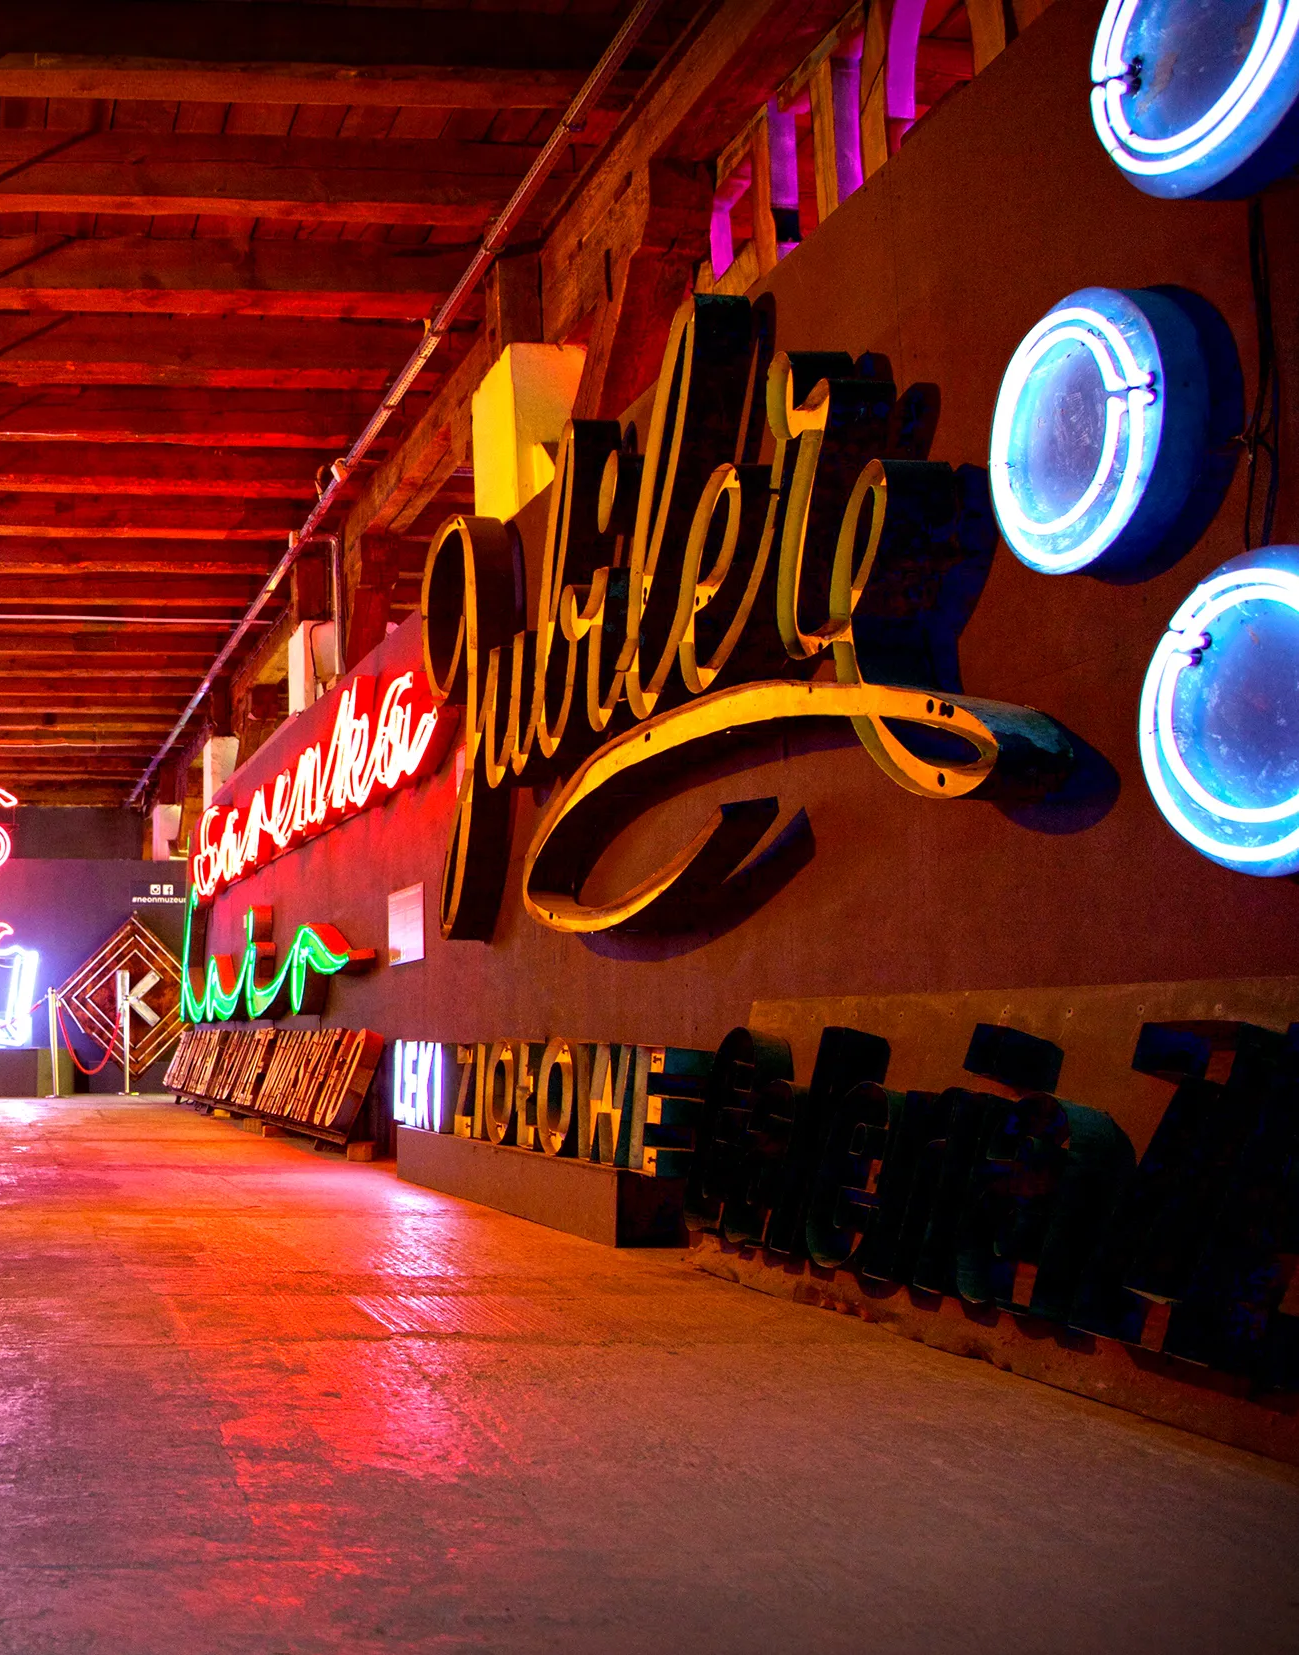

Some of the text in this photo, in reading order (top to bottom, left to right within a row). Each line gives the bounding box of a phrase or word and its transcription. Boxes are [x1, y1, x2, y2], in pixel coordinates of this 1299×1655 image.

[423, 293, 1071, 942] Jubiler
[115, 969, 161, 1028] K
[392, 1036, 673, 1177] LEKI ZIOŁOWE
